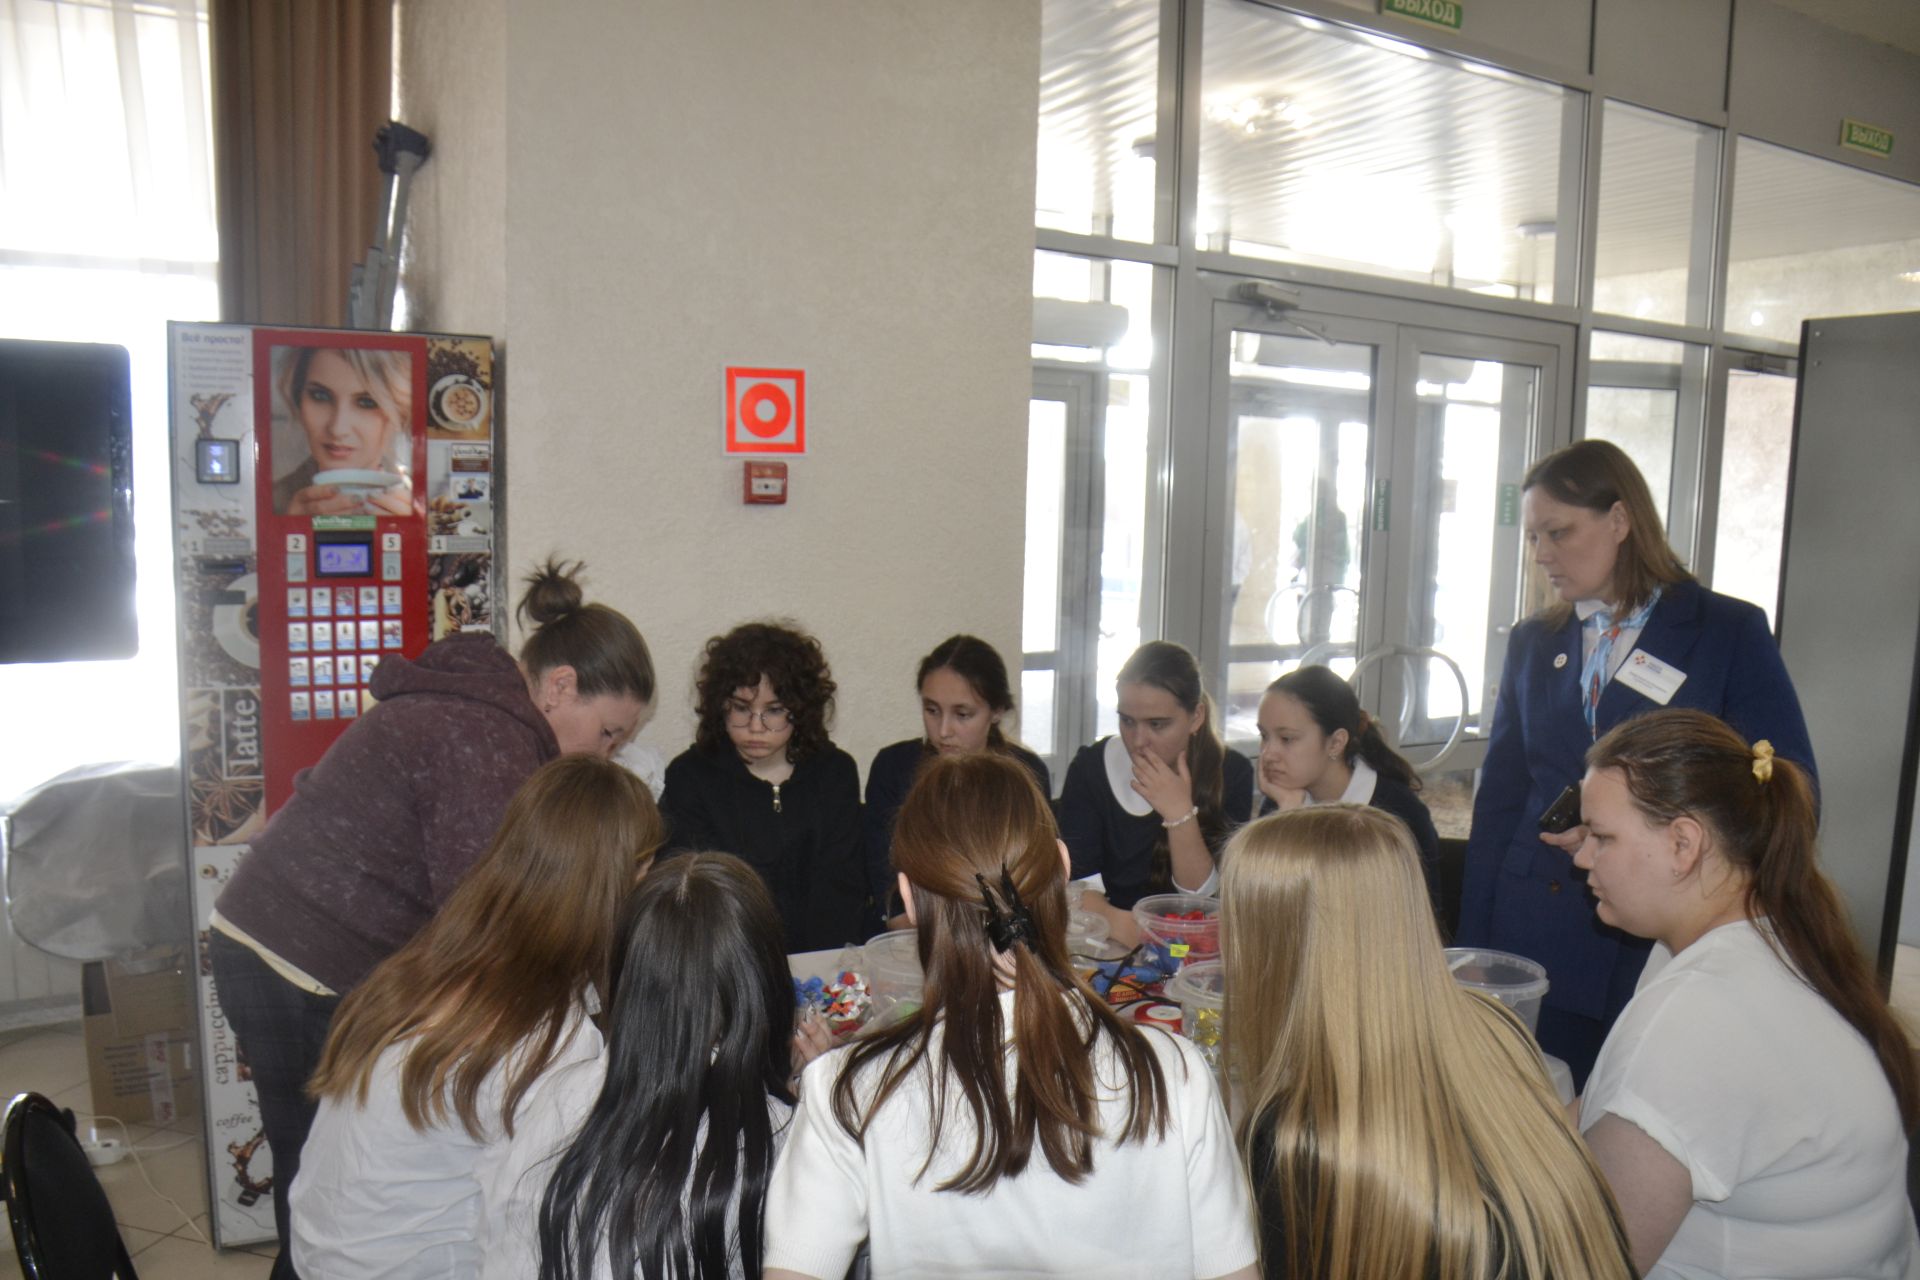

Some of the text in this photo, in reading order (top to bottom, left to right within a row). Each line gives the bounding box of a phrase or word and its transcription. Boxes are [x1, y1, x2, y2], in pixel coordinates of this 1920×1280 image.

[1852, 125, 1888, 150] ВЫХОД
[292, 538, 300, 549] 2
[388, 537, 395, 548] 5
[435, 539, 442, 550] 1
[229, 699, 258, 769] latte
[216, 1113, 253, 1128] coffee
